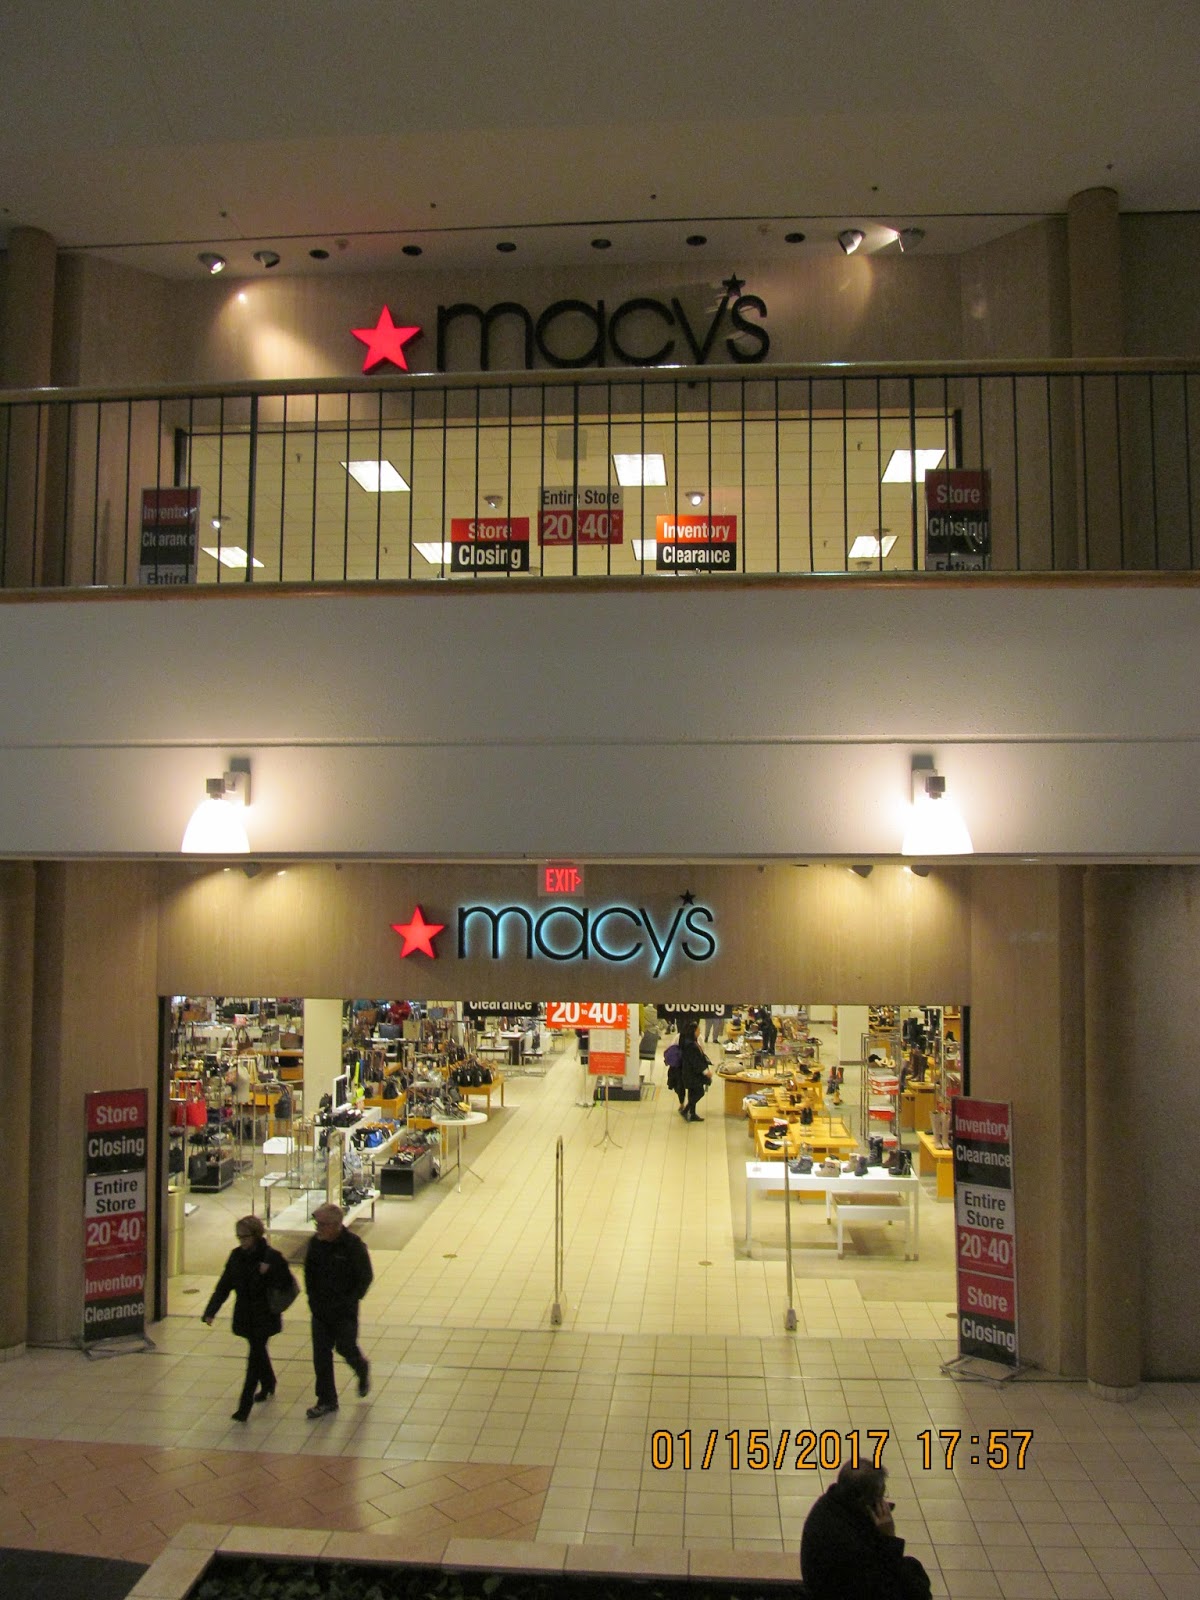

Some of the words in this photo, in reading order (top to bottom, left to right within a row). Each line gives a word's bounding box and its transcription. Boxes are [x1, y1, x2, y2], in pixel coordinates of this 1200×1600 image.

[936, 484, 981, 504] Store
[468, 522, 513, 540] Store
[543, 514, 573, 540] 20
[582, 513, 613, 539] 40
[663, 522, 731, 542] Inventory
[928, 517, 989, 541] Closing
[458, 544, 522, 569] Closing
[662, 545, 731, 564] Clearance
[545, 867, 578, 893] EXIT
[551, 1002, 580, 1023] 20
[588, 1002, 618, 1024] 40
[96, 1105, 138, 1125] Store
[955, 1115, 1010, 1139] Inventory
[88, 1135, 145, 1158] Closing
[956, 1145, 1012, 1167] Clearance
[94, 1179, 138, 1196] Entire
[95, 1198, 136, 1214] Store
[964, 1191, 1006, 1211] Entire
[966, 1210, 1004, 1230] Store
[87, 1221, 111, 1247] 20
[117, 1217, 140, 1242] 40
[960, 1232, 982, 1259] 20
[987, 1238, 1010, 1265] 40
[85, 1273, 145, 1294] Inventory
[967, 1285, 1008, 1313] Store
[85, 1301, 145, 1324] Clearance
[961, 1317, 1016, 1353] Closing
